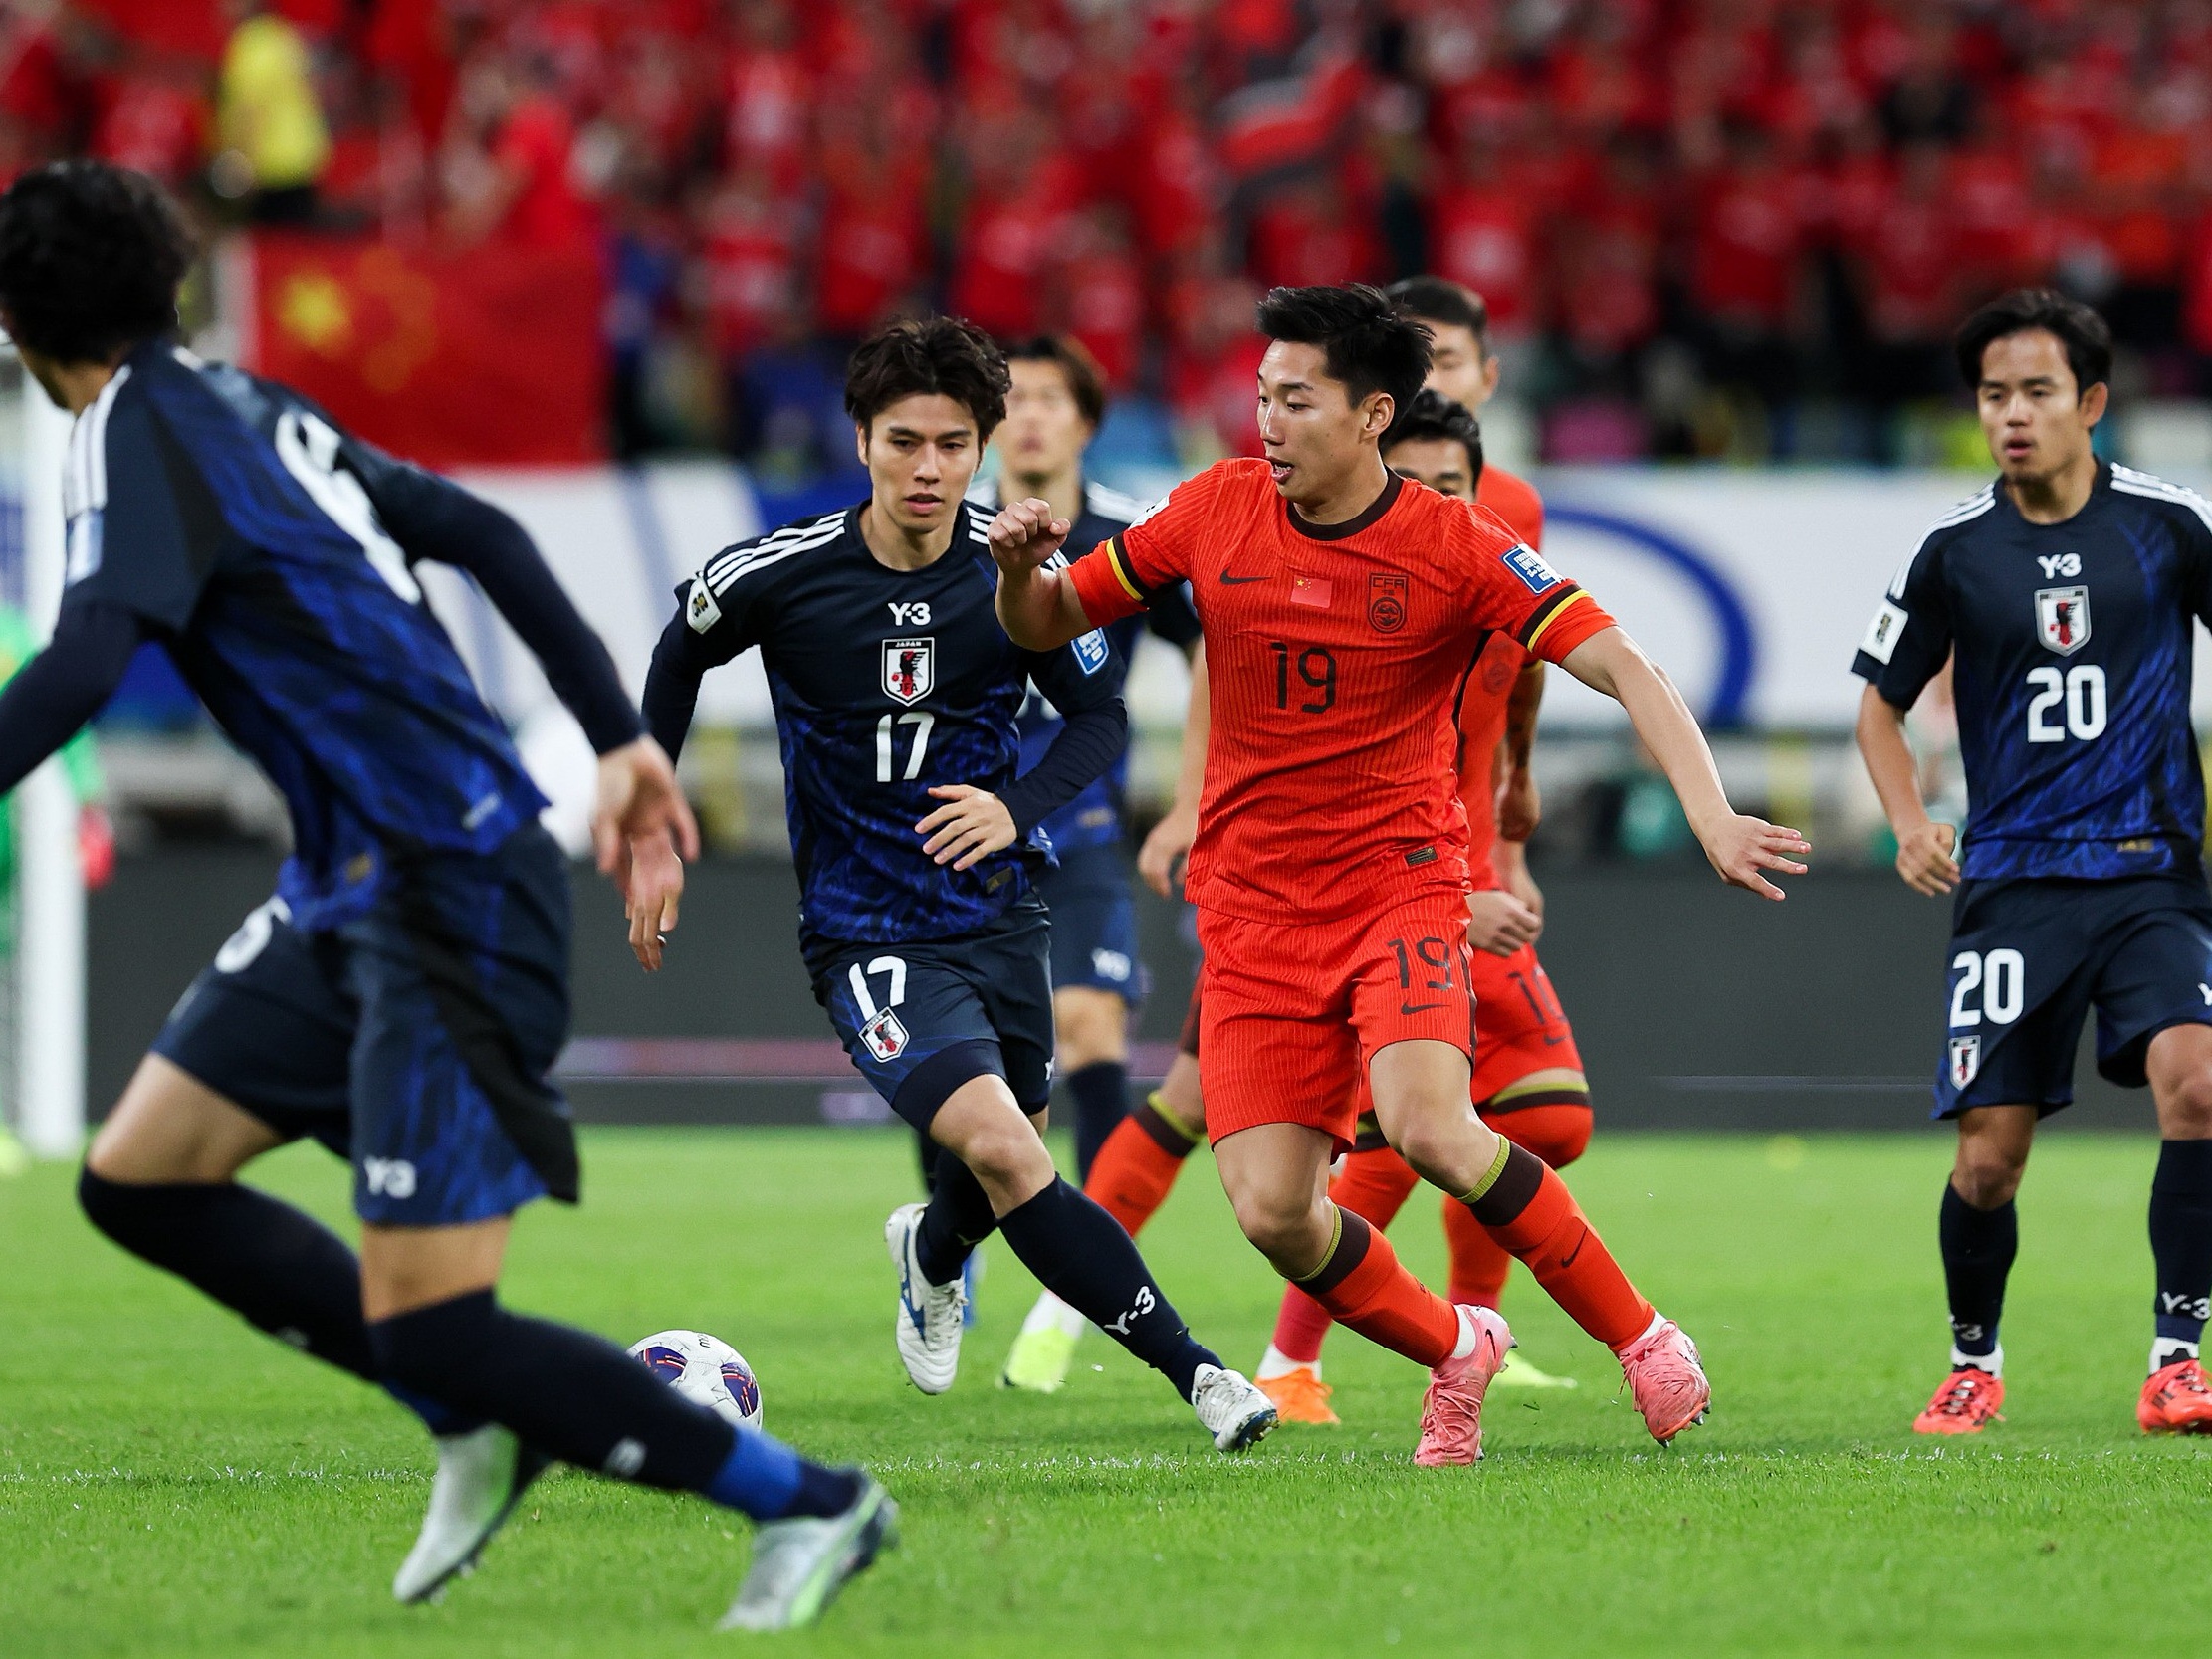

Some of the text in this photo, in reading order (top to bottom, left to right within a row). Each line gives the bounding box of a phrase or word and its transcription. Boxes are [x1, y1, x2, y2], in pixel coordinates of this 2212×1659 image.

[2036, 552, 2083, 580] Y-3
[887, 602, 932, 627] Y-3
[1270, 642, 1337, 715] 19
[2025, 664, 2107, 743] 20
[875, 711, 936, 783] 17
[848, 955, 907, 1022] 17
[1387, 936, 1454, 992] 19
[1949, 947, 2025, 1029] 20
[1104, 1285, 1156, 1336] Y-3
[2161, 1290, 2211, 1321] Y-3
